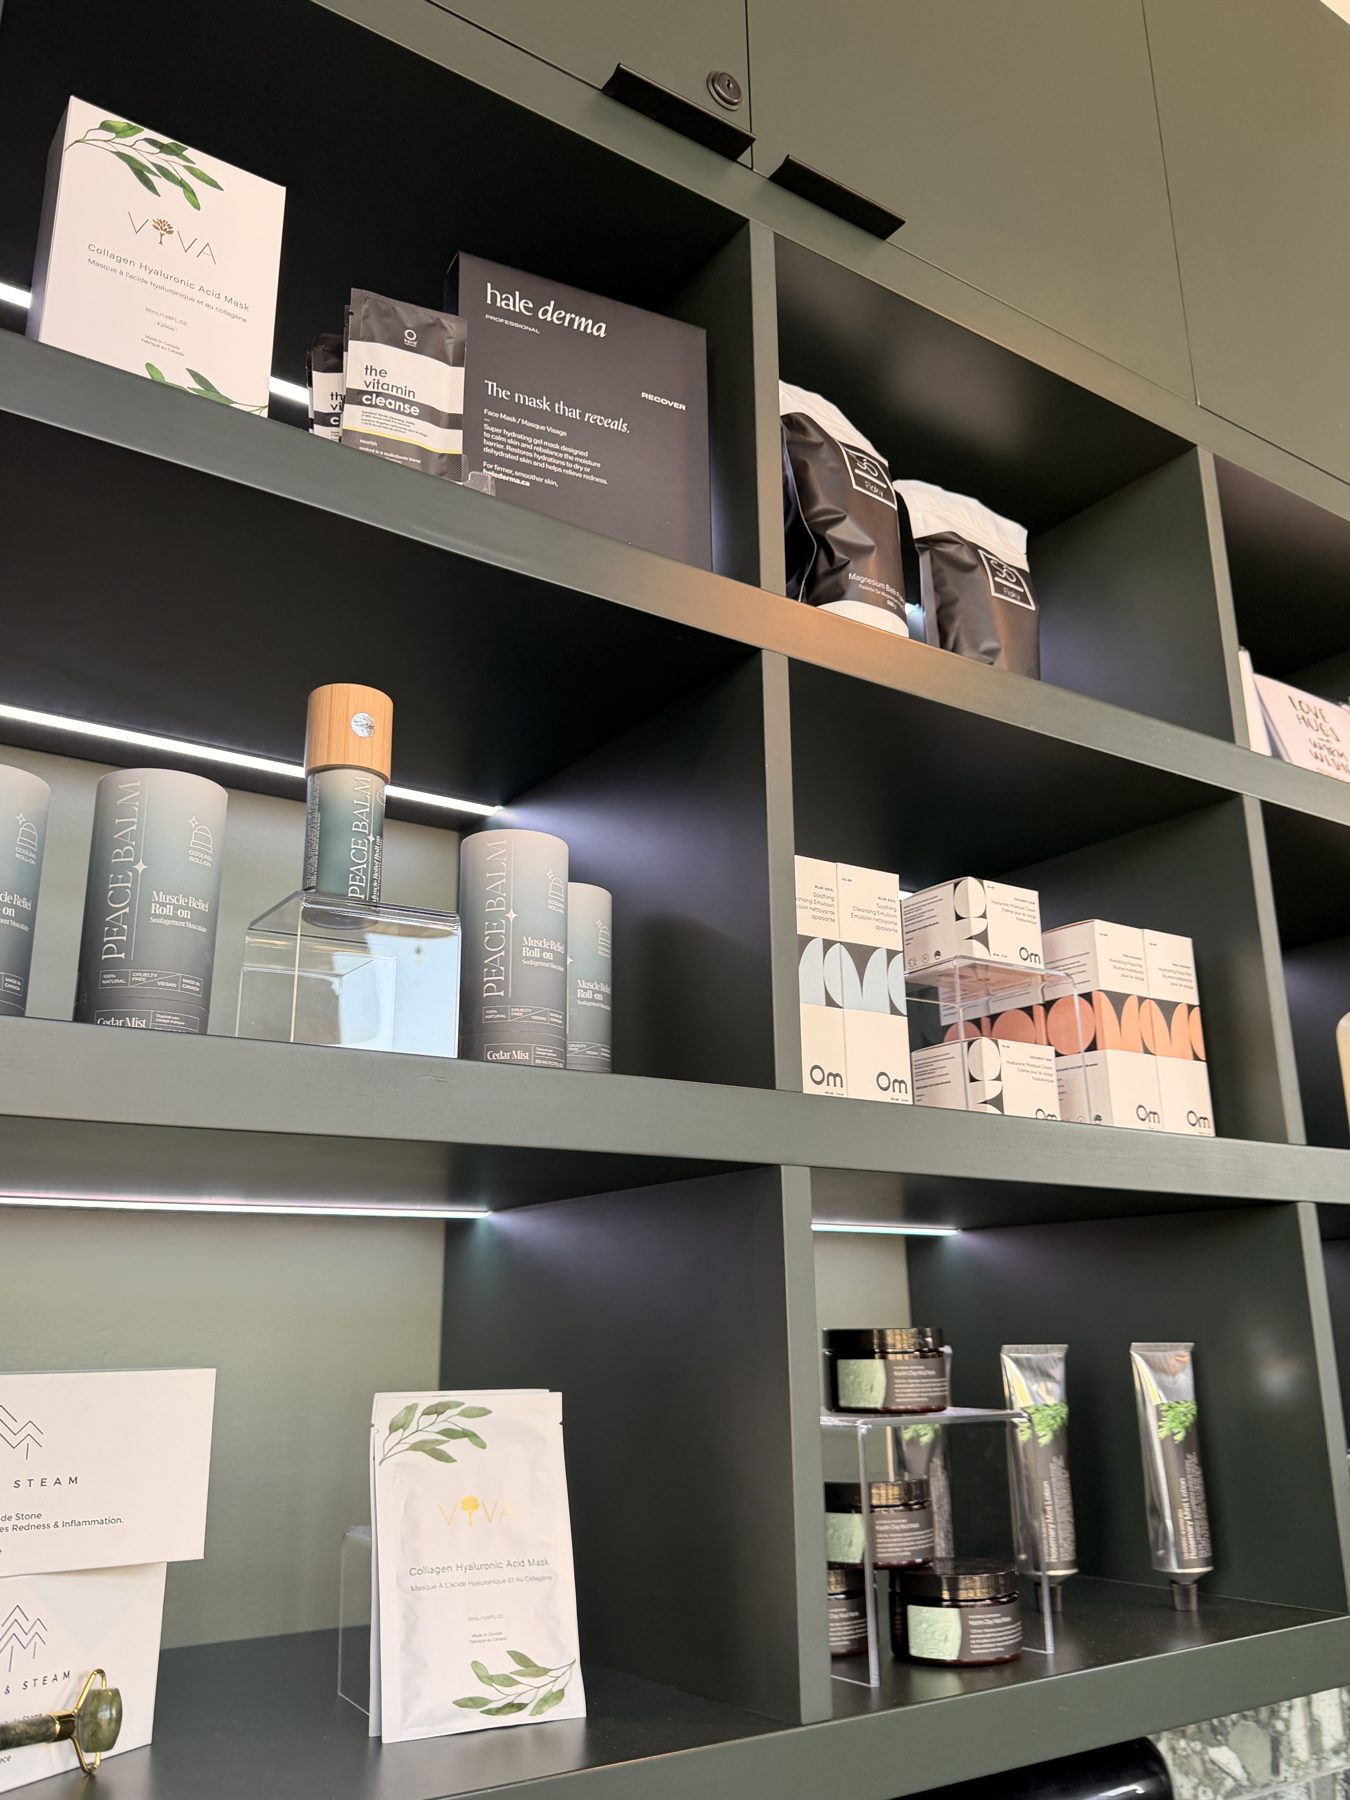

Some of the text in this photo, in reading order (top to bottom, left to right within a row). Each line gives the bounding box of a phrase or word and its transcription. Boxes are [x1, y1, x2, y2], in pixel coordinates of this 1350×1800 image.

[87, 243, 250, 312] Collagen Hyaluronic Acid Mask
[87, 257, 118, 273] Masque
[150, 280, 196, 303] hyaluronique
[486, 282, 608, 338] hale derma
[485, 313, 541, 334] PROFESSIONAL
[364, 365, 388, 378] the
[363, 378, 416, 400] vitamin
[361, 393, 421, 416] cleanse
[484, 380, 631, 434] The mask that reveals.
[641, 391, 687, 411] RECOVER
[483, 408, 499, 418] Face
[500, 412, 518, 423] Mask
[521, 419, 547, 431] Masque
[546, 426, 567, 437] Visage
[483, 423, 503, 435] Super
[503, 428, 533, 443] hydrating
[543, 440, 560, 450] mask
[560, 445, 589, 458] designed
[490, 433, 507, 443] calm
[507, 438, 521, 447] skin
[520, 442, 533, 450] and
[533, 445, 563, 459] rebalance
[563, 453, 575, 461] the
[575, 456, 601, 468] moisture
[483, 445, 519, 461] dehydrated
[519, 456, 533, 465] skin
[532, 460, 545, 468] and
[545, 462, 563, 474] helps
[505, 444, 533, 458] Restores
[565, 460, 573, 468] to
[573, 462, 584, 472] dry
[482, 460, 494, 470] For
[514, 470, 543, 483] smoother
[482, 468, 531, 487] halederma.ca
[848, 572, 886, 590] Magnesium
[348, 776, 373, 900] PEACE BALM
[101, 780, 141, 961] PEACE BALM
[151, 903, 191, 919] Roll-on
[152, 890, 209, 912] Muscle Relief
[483, 839, 508, 999] PEACE BALM
[522, 935, 551, 950] Muscle
[522, 946, 553, 960] Roll-on
[1019, 946, 1041, 965] Om
[157, 980, 177, 988] VEGAN
[126, 1017, 147, 1028] Mist
[486, 1050, 512, 1061] Cedar
[512, 1051, 529, 1061] Mist
[810, 1064, 844, 1088] Om
[876, 1071, 908, 1095] Om
[1136, 1104, 1160, 1124] Om
[1186, 1110, 1211, 1129] Om
[13, 1476, 79, 1489] STEAM
[11, 1522, 51, 1532] Redness
[53, 1520, 60, 1529] &
[61, 1516, 124, 1529] Inflammation.
[15, 1512, 43, 1521] Stone
[409, 1557, 550, 1577] Collagen Hyaluronic Acid Mask
[22, 1670, 71, 1690] STEAM
